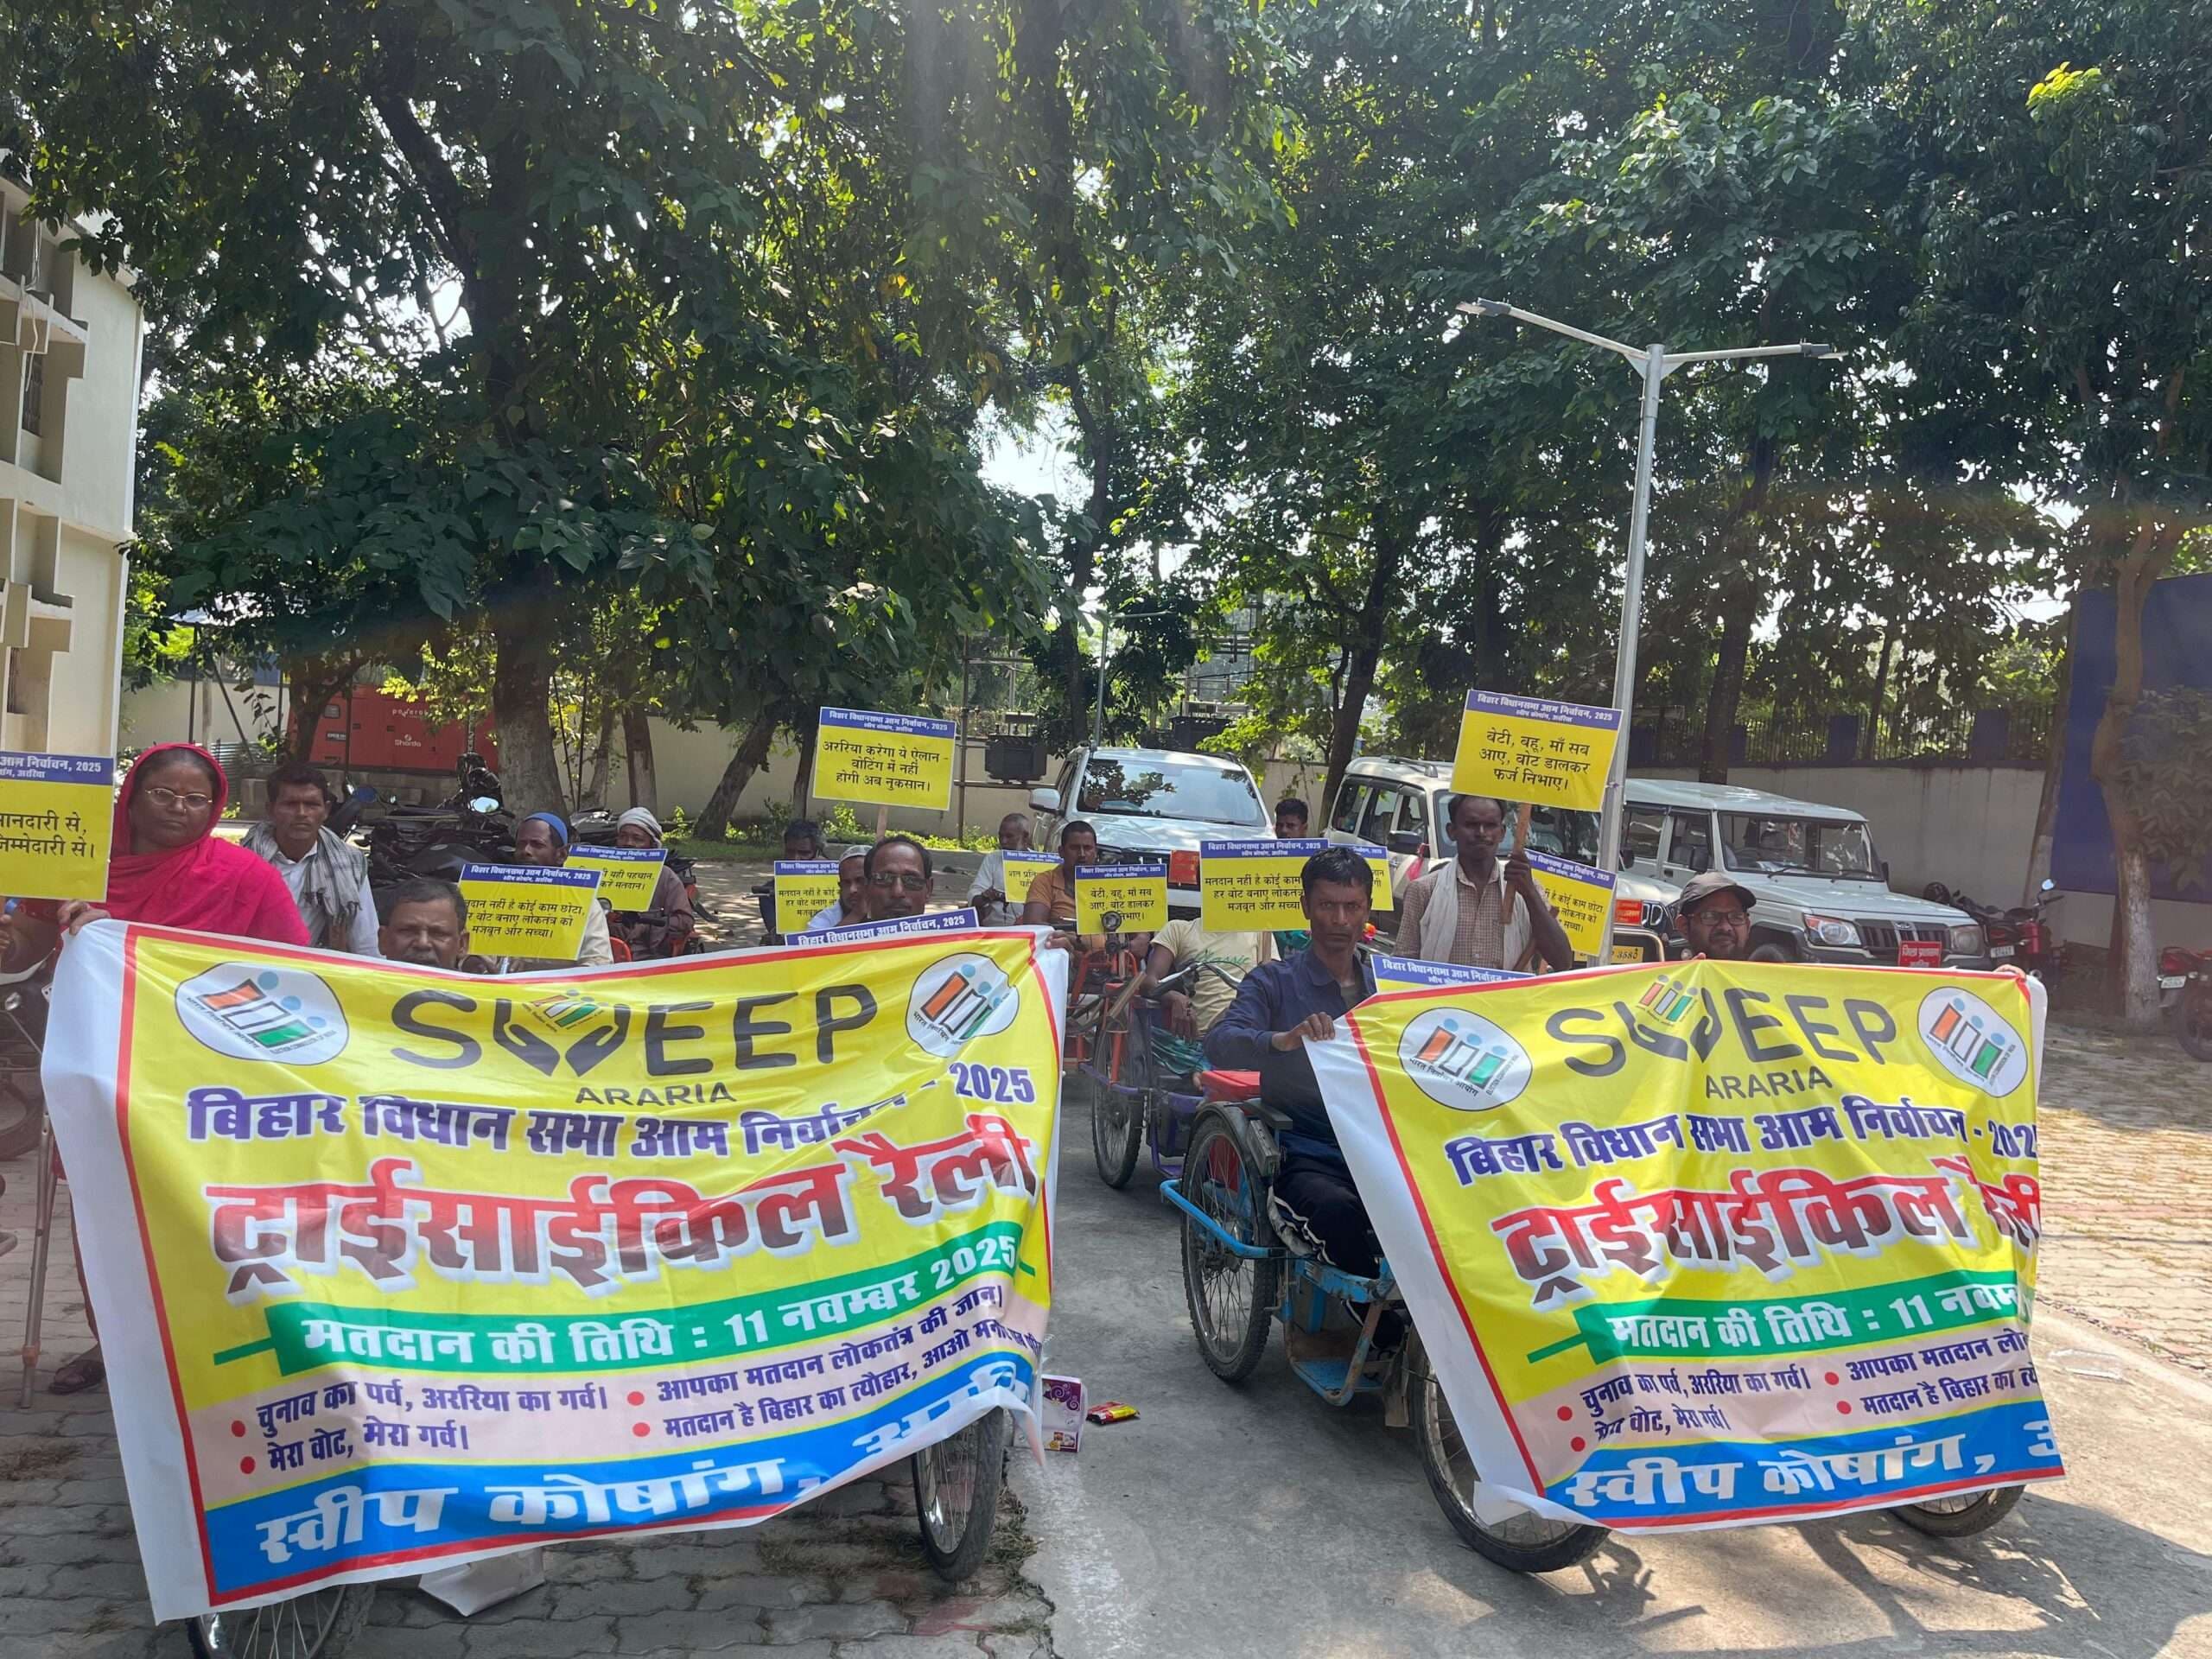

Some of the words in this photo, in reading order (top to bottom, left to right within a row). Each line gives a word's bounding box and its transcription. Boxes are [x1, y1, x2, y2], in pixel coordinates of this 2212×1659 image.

[76, 761, 101, 772] 2025
[943, 915, 965, 927] 2025
[188, 1087, 346, 1141] बिहार
[359, 1096, 515, 1150] विधान
[526, 1109, 626, 1156] सभा
[631, 1116, 729, 1156] आम
[951, 1061, 1035, 1103] 2025
[575, 1082, 737, 1106] ARARIA
[1706, 1065, 1833, 1100] ARARIA
[1446, 1135, 1564, 1185] बिहार
[1562, 1116, 1683, 1166] विधान
[1686, 1114, 1751, 1154] सभा
[1755, 1105, 1842, 1152] आम
[1843, 1096, 1967, 1143] निर्वाचन
[1988, 1120, 2037, 1157] 202
[207, 1159, 847, 1294] ट्राईसाईकिल
[831, 1114, 1036, 1217] रैली
[302, 1319, 474, 1363] मतदान
[488, 1322, 556, 1363] की
[570, 1319, 674, 1364] तिथि
[724, 1310, 768, 1346] 11
[779, 1270, 920, 1332] नवम्बर
[931, 1236, 1016, 1286] 2025
[1605, 1316, 1708, 1349] मतदान
[1713, 1306, 1761, 1347] की
[1765, 1302, 1854, 1345] तिथि
[1890, 1295, 1933, 1329] 11
[657, 1372, 739, 1402] आपका
[744, 1356, 824, 1387] मतदान
[829, 1325, 915, 1370] लोकतंत्र
[918, 1306, 948, 1334] की
[1846, 1353, 1917, 1382] आपका
[1919, 1338, 1992, 1368] मतदान
[257, 1390, 316, 1438] चुनाव
[323, 1382, 358, 1409] का
[366, 1379, 412, 1412] पर्व,
[423, 1384, 510, 1412] अररिया
[518, 1387, 551, 1411] का
[558, 1382, 607, 1412] गर्व।
[664, 1410, 734, 1438] मतदान
[737, 1402, 755, 1427] है
[758, 1395, 815, 1424] बिहार
[817, 1386, 847, 1410] का
[921, 1329, 970, 1370] आओ
[1580, 1375, 1634, 1417] चुनाव
[1635, 1374, 1660, 1394] का
[1658, 1369, 1688, 1397] पर्व,
[1689, 1369, 1742, 1395] अररिया
[1745, 1373, 1766, 1392] का
[1859, 1390, 1920, 1414] मतदान
[1926, 1382, 1940, 1405] है
[1942, 1376, 1991, 1403] बिहार
[1993, 1371, 2015, 1389] का
[268, 1439, 304, 1472] मेरा
[312, 1427, 353, 1463] वोट,
[364, 1415, 410, 1447] मेरा
[418, 1419, 469, 1451] गर्व।
[1630, 1406, 1671, 1435] वोट,
[1674, 1404, 1700, 1429] मेरा
[1566, 1457, 1744, 1507] स्वीप
[256, 1484, 459, 1565] स्वीप
